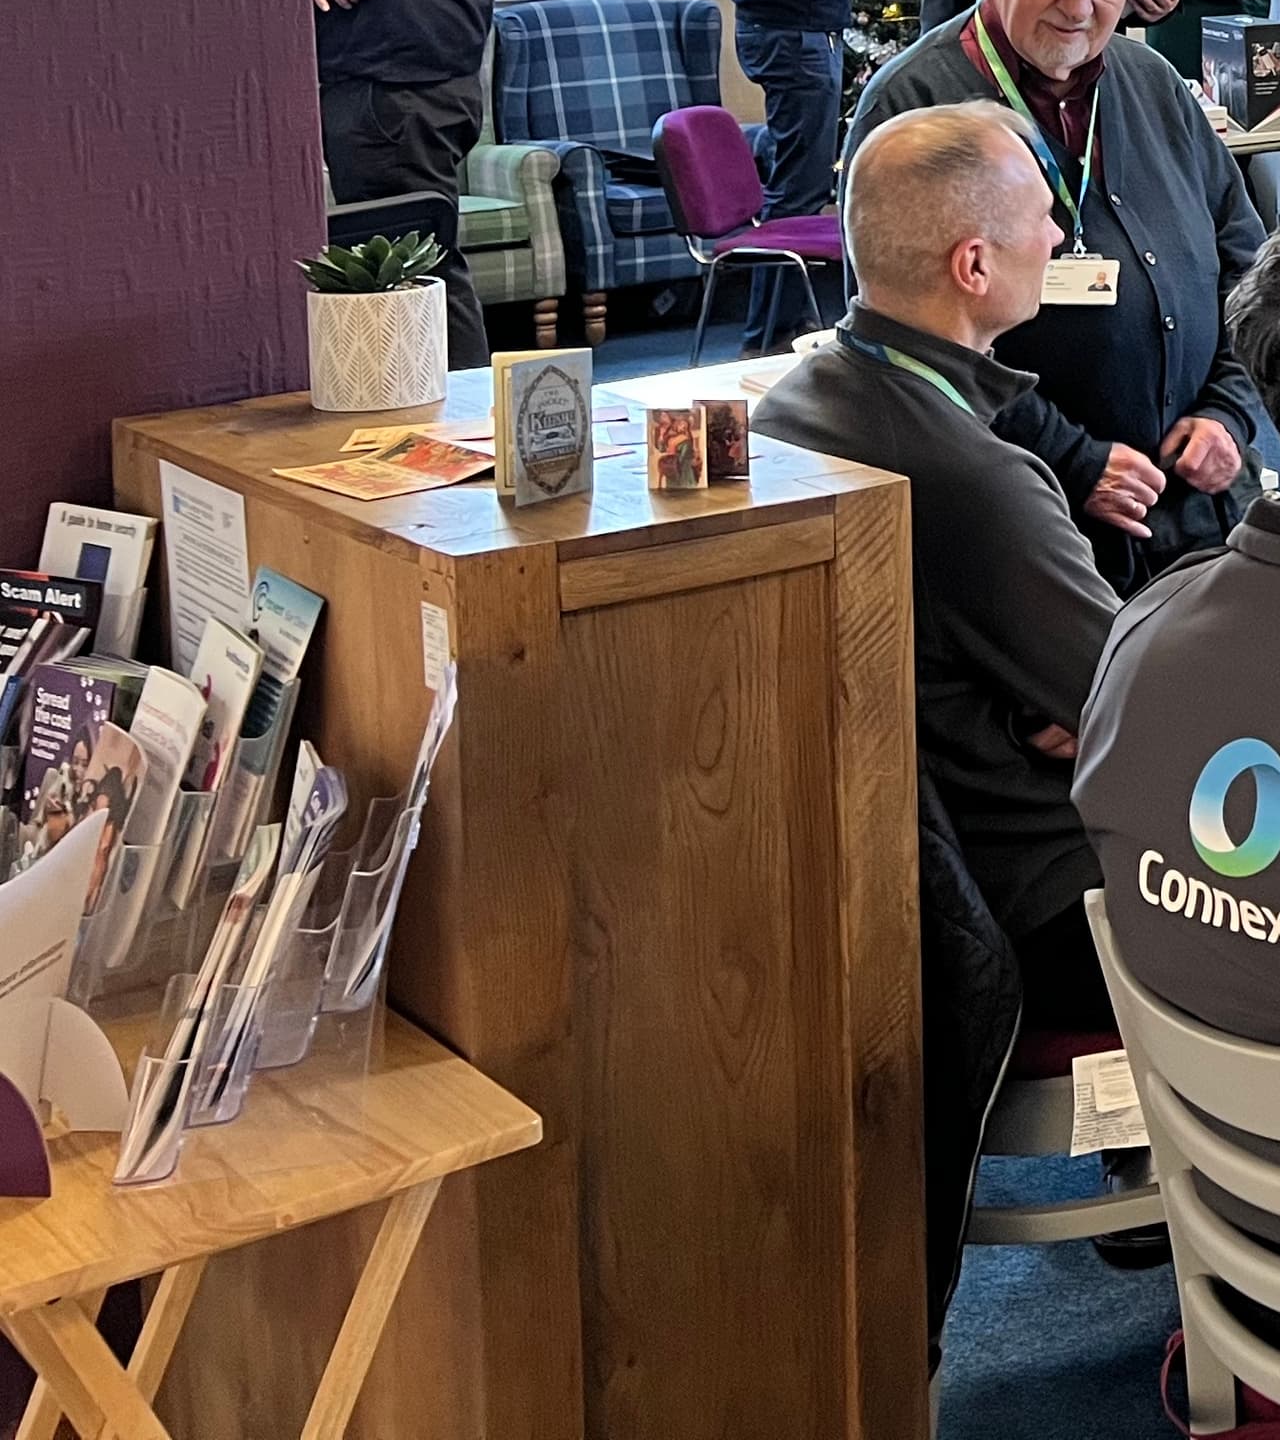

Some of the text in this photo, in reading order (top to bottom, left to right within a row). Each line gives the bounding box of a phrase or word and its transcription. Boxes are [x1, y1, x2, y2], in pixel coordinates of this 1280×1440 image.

[0, 582, 82, 608] Scam Alert
[37, 687, 71, 710] Spread
[35, 707, 72, 730] the cost
